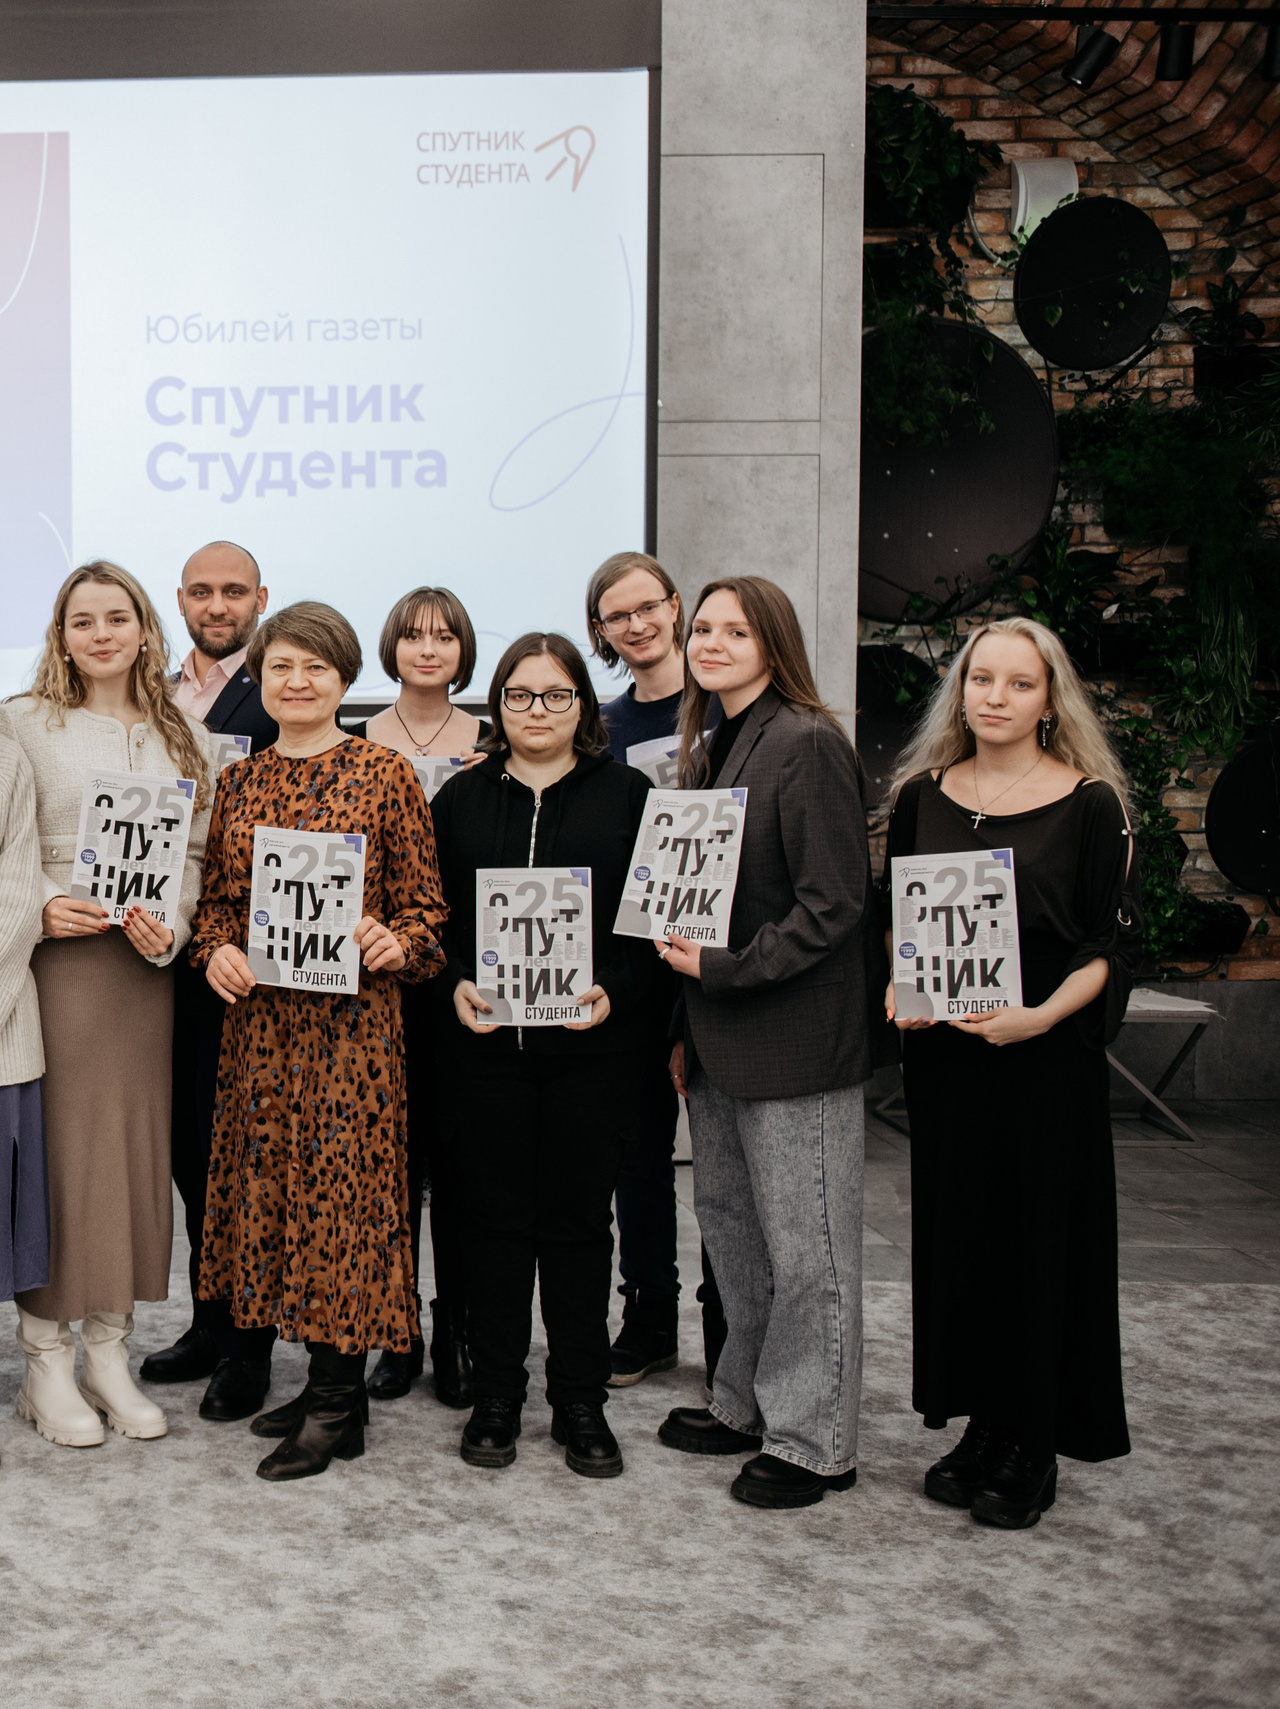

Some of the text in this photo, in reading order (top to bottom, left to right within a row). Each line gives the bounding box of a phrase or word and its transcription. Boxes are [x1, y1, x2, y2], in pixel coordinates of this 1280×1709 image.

[417, 131, 526, 152] СПУТНИК
[417, 163, 530, 188] СТУДЕНТА
[146, 313, 422, 344] Юбилей газеты
[145, 376, 425, 438] Спутник
[146, 441, 447, 503] Студента
[121, 786, 184, 831] 25
[678, 798, 737, 846] 25
[120, 860, 147, 871] лет
[288, 842, 355, 890] 25
[673, 876, 701, 887] лет
[933, 860, 1007, 913] 25
[515, 877, 583, 925] 25
[293, 921, 321, 932] лет
[664, 925, 716, 940] СТУДЕНТА
[523, 956, 552, 967] лет
[944, 947, 976, 958] лет
[292, 970, 347, 986] СТУДЕНТА
[525, 1007, 580, 1020] СТУДЕНТА
